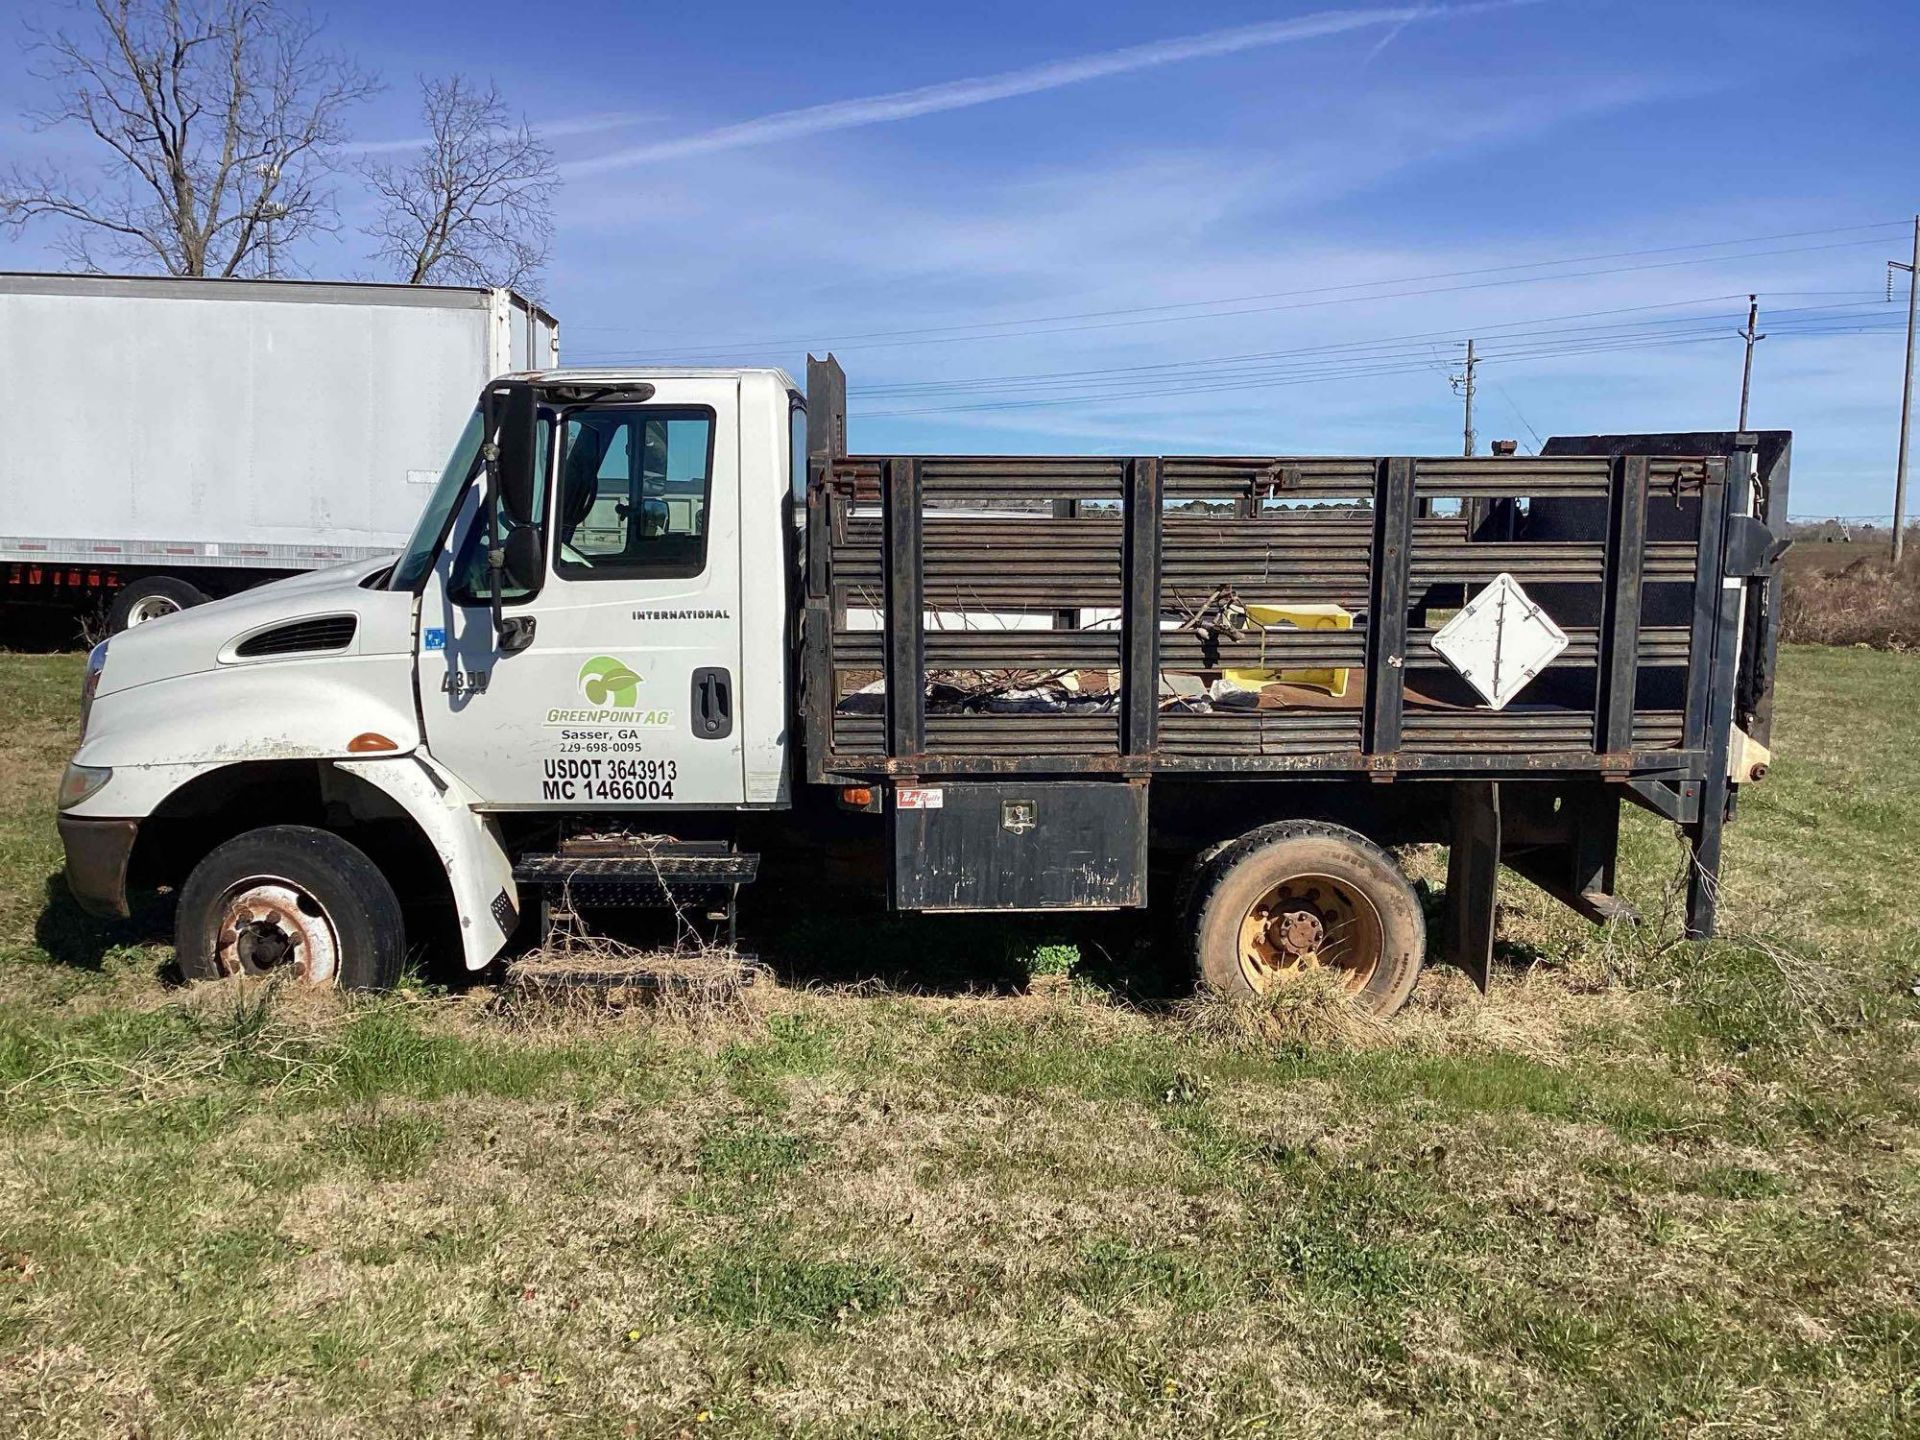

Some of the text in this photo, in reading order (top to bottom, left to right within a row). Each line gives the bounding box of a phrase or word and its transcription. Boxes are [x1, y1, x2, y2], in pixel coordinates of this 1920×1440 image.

[632, 610, 730, 620] INTERNATIONAL
[547, 709, 670, 725] GREENPOINT AG
[561, 729, 639, 741] Sasser, GA
[560, 742, 642, 753] 229-698-0095
[544, 758, 677, 780] USDOT 3643913
[543, 780, 674, 800] MC 1466004
